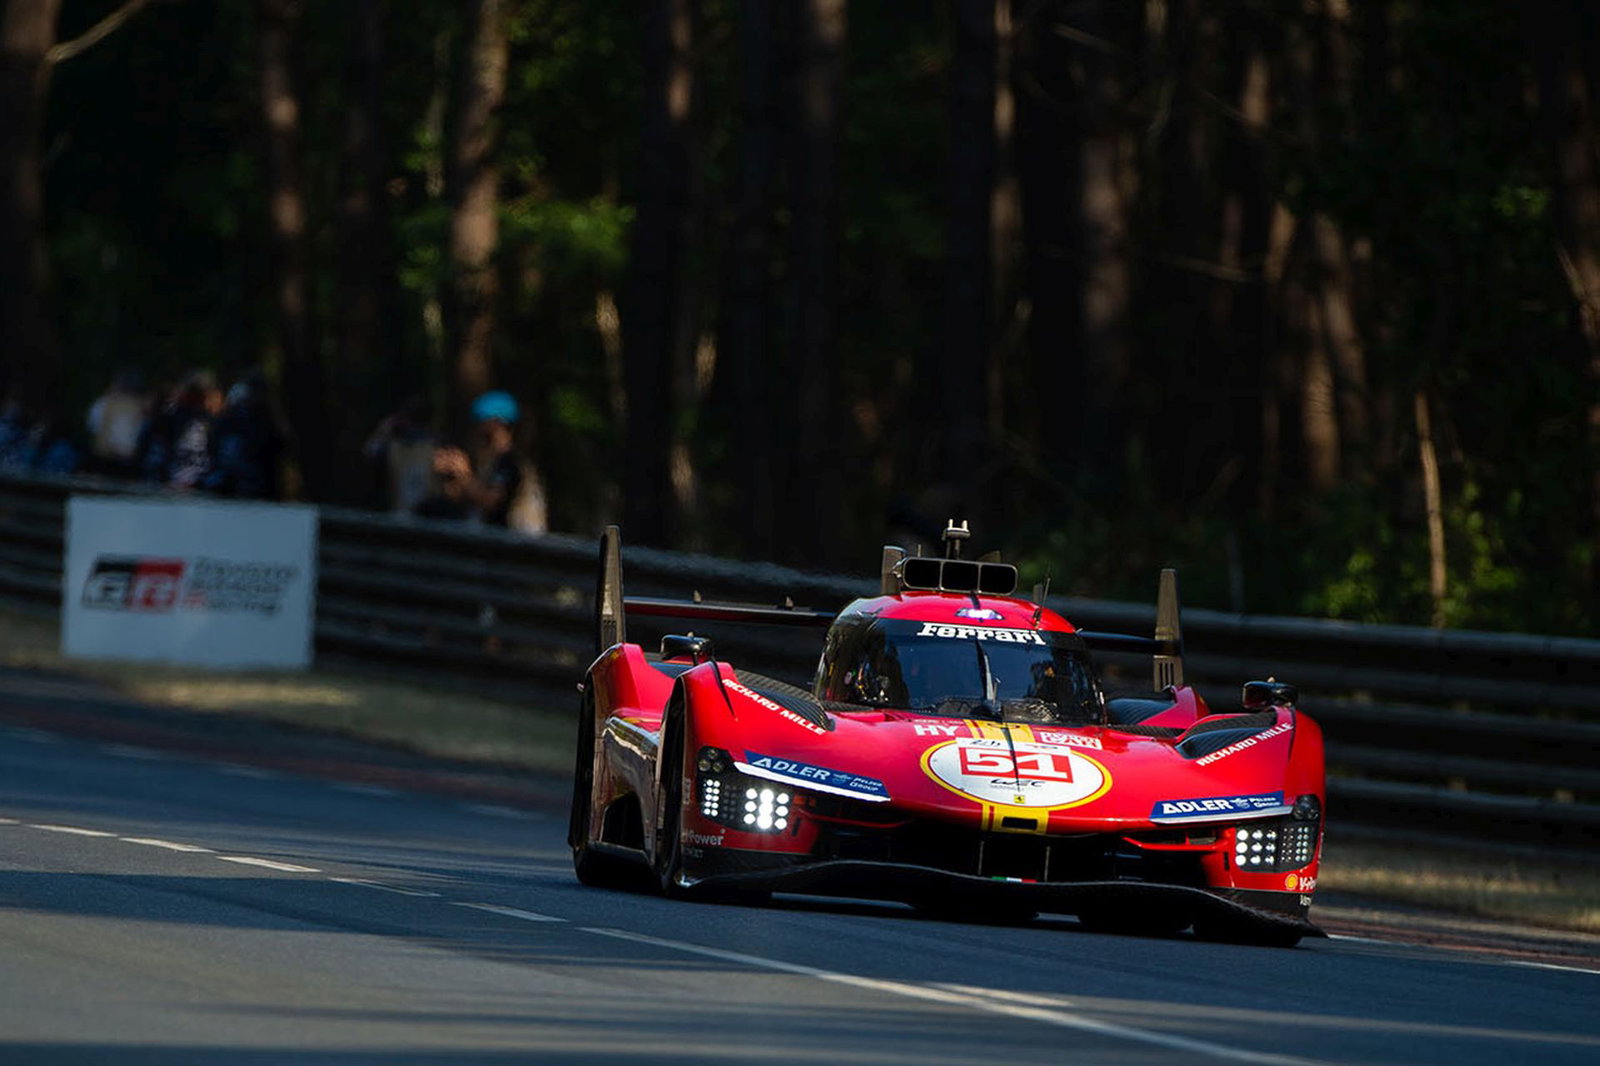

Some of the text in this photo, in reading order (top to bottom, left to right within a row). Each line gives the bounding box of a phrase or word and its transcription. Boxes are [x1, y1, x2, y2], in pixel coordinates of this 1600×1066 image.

[917, 622, 1047, 646] Ferrari
[721, 678, 827, 735] RICHARD MILLE
[913, 724, 960, 737] HY
[1196, 722, 1295, 767] RICHARD MILLE
[752, 757, 831, 781] ADLER
[966, 748, 1069, 780] 51
[1162, 799, 1234, 814] ADLER
